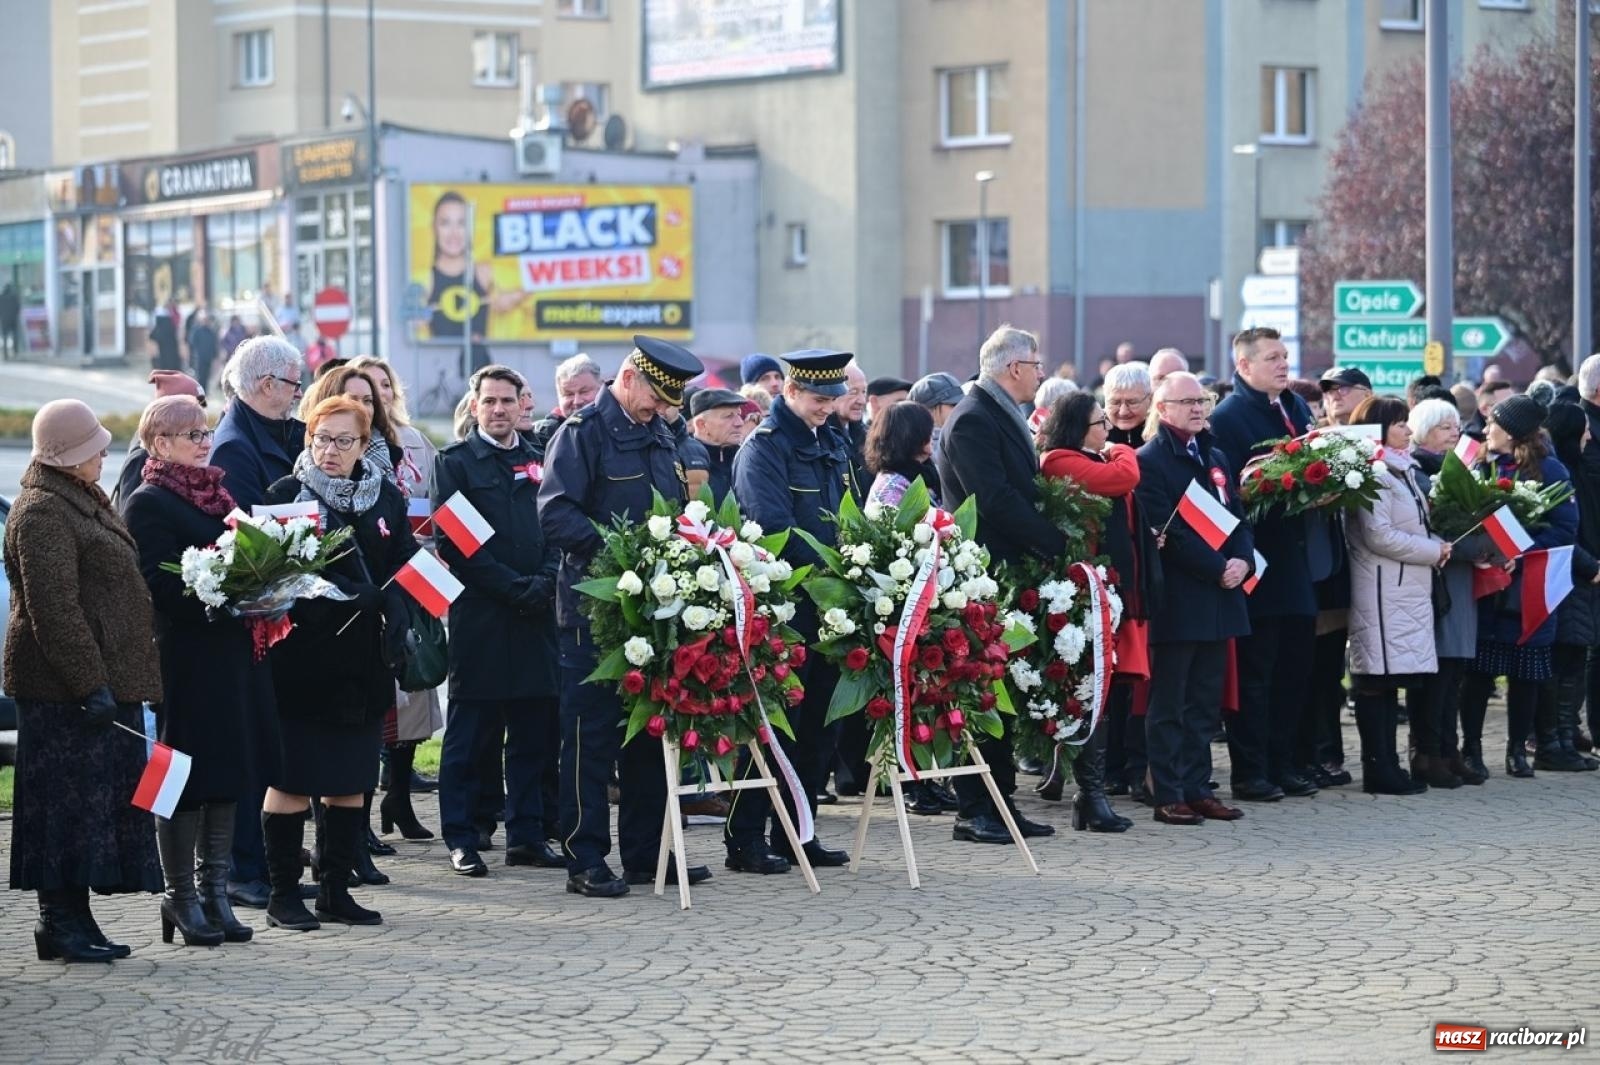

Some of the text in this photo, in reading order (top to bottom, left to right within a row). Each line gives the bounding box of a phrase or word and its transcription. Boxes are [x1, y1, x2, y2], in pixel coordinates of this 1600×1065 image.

[501, 205, 653, 253] BLACK
[527, 255, 643, 284] WEEKS!
[542, 303, 662, 327] mediaexpert
[1345, 289, 1400, 315] Opole
